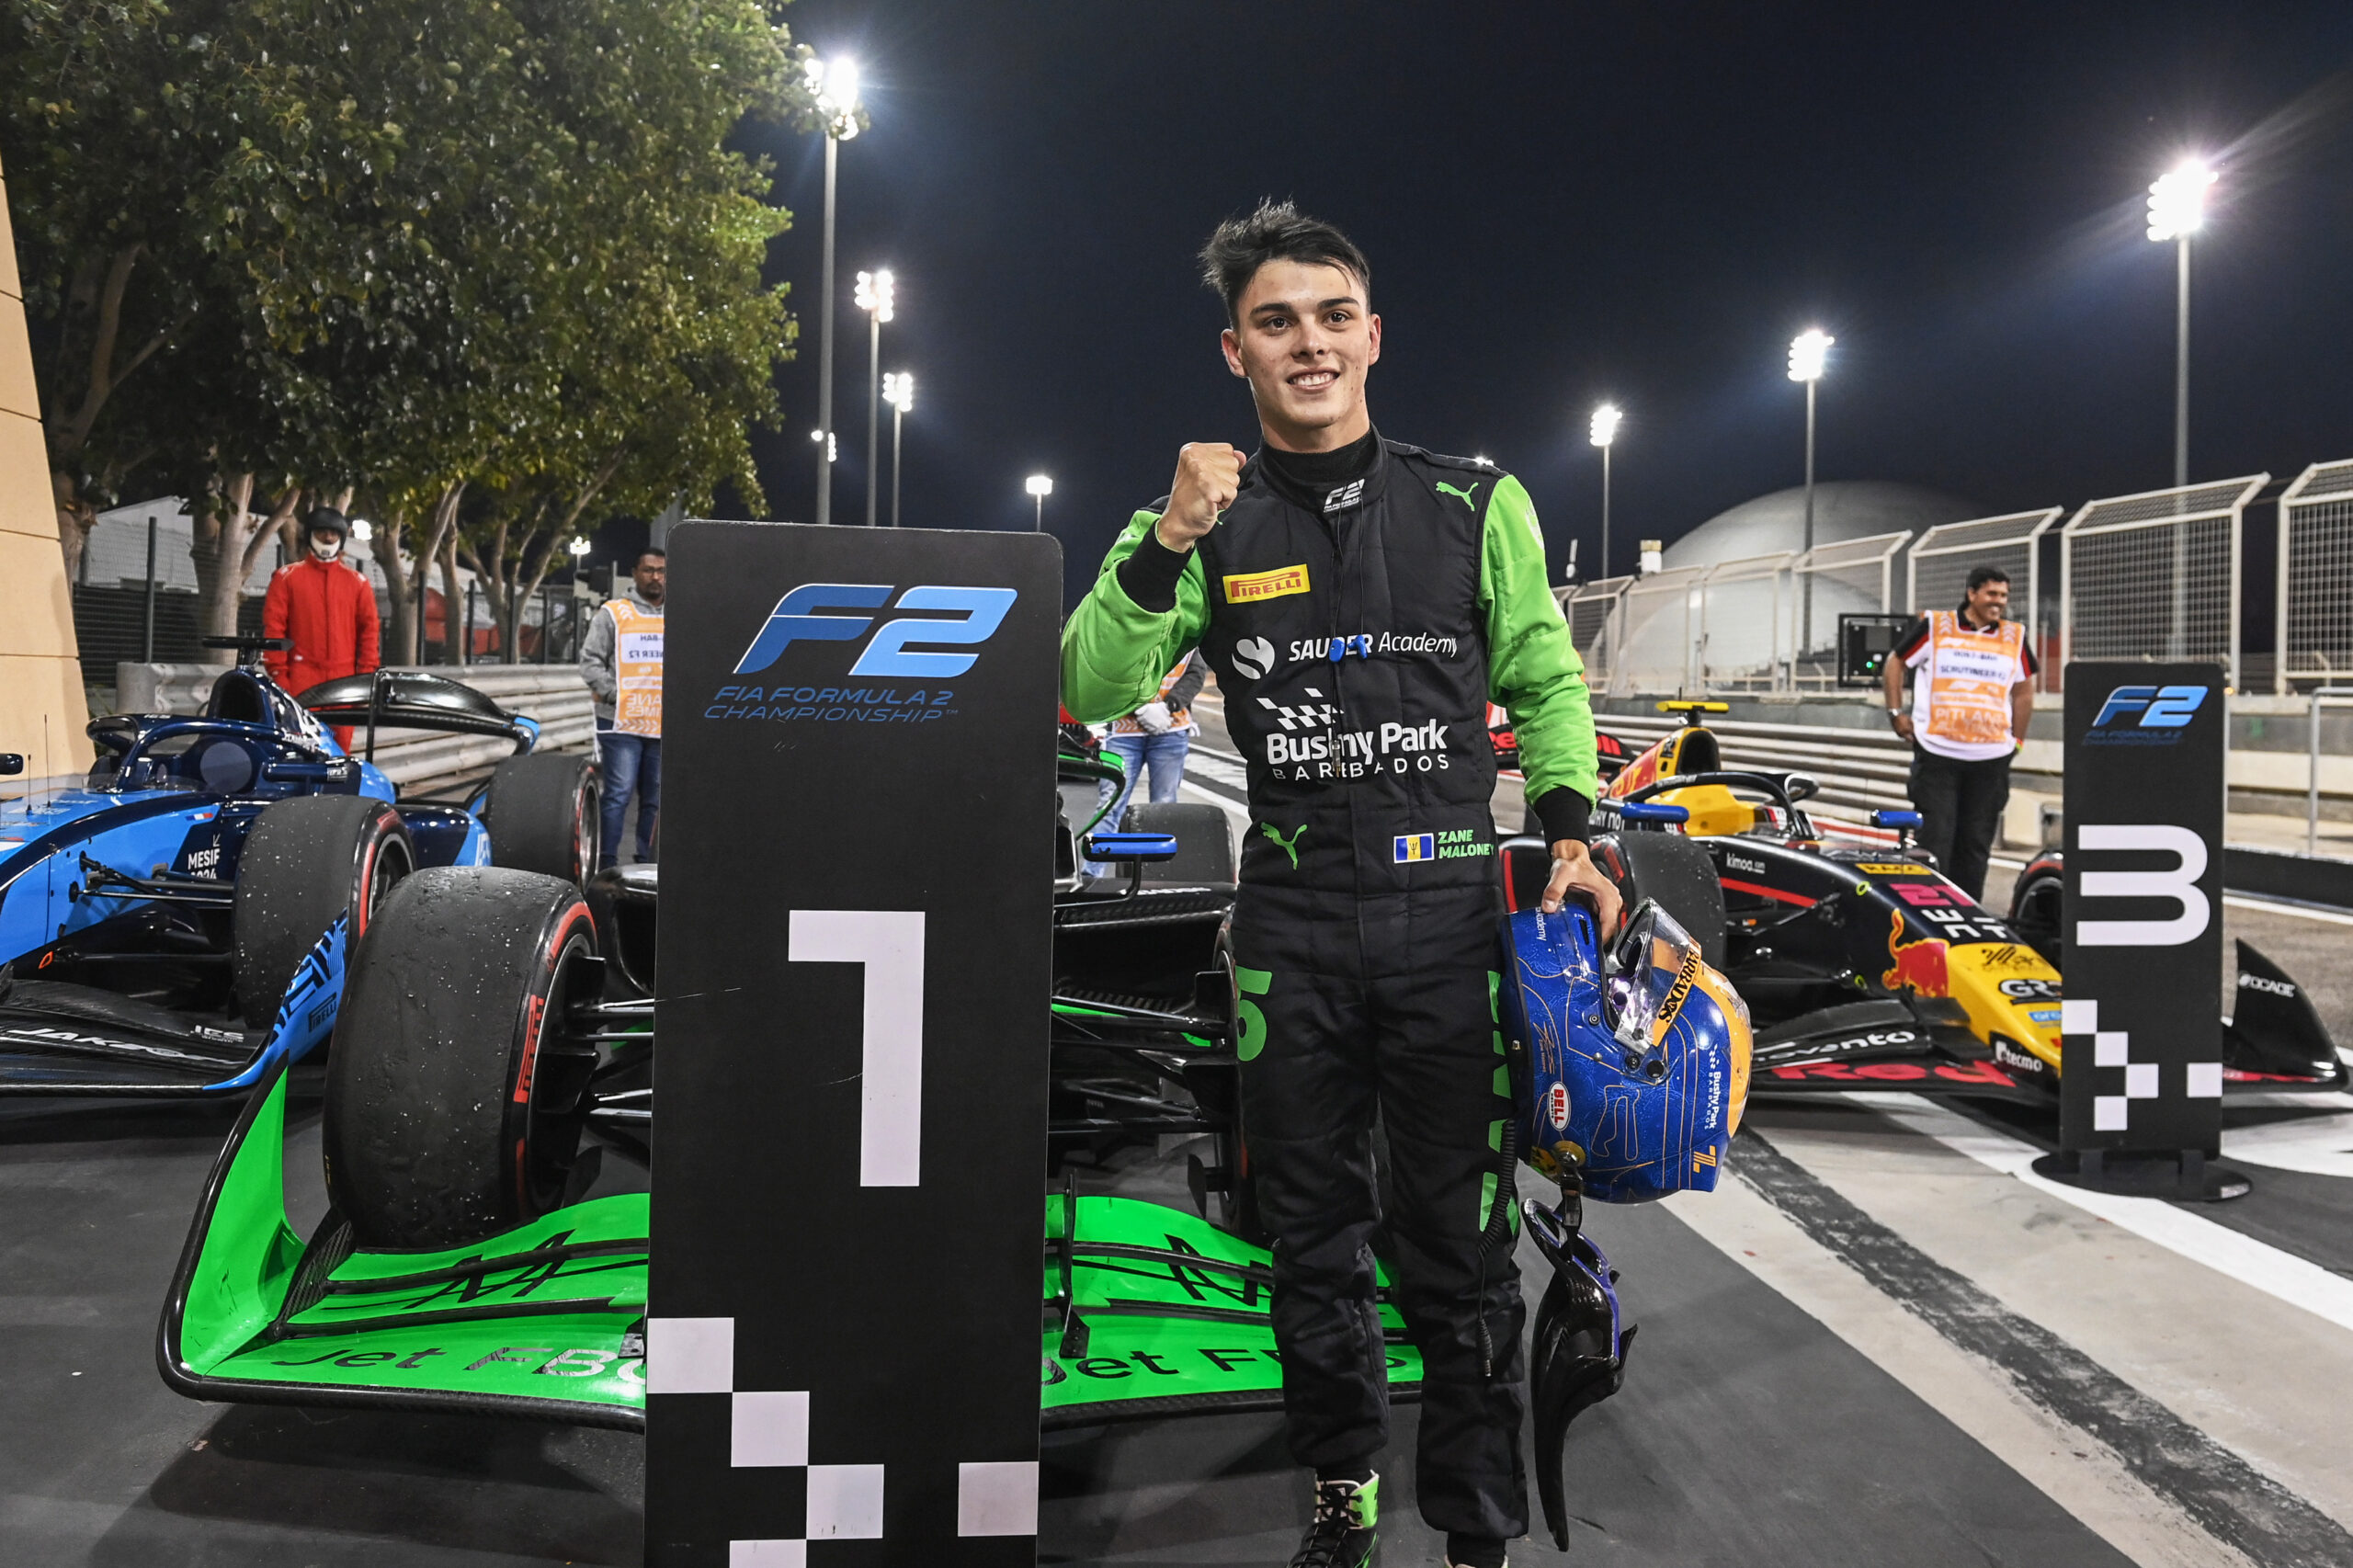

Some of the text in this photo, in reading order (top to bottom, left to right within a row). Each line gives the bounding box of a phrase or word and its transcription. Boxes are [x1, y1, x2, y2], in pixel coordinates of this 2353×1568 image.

[1230, 570, 1302, 597] PIRELLI
[733, 583, 1017, 678] F2
[1289, 631, 1458, 662] SAUER Academy
[713, 686, 954, 706] FIA FORMULA 2
[2092, 685, 2209, 728] F2
[704, 706, 944, 723] CHAMPIONSHIP
[1381, 718, 1449, 754] Park
[1438, 830, 1474, 845] ZANE
[1438, 842, 1495, 859] MALONEY
[188, 848, 221, 870] MESIF
[2076, 824, 2211, 946] 3
[788, 909, 926, 1188] 1
[1553, 1088, 1565, 1124] BELL
[1709, 1071, 1722, 1130] Bushy Park
[271, 1347, 447, 1369] Jet
